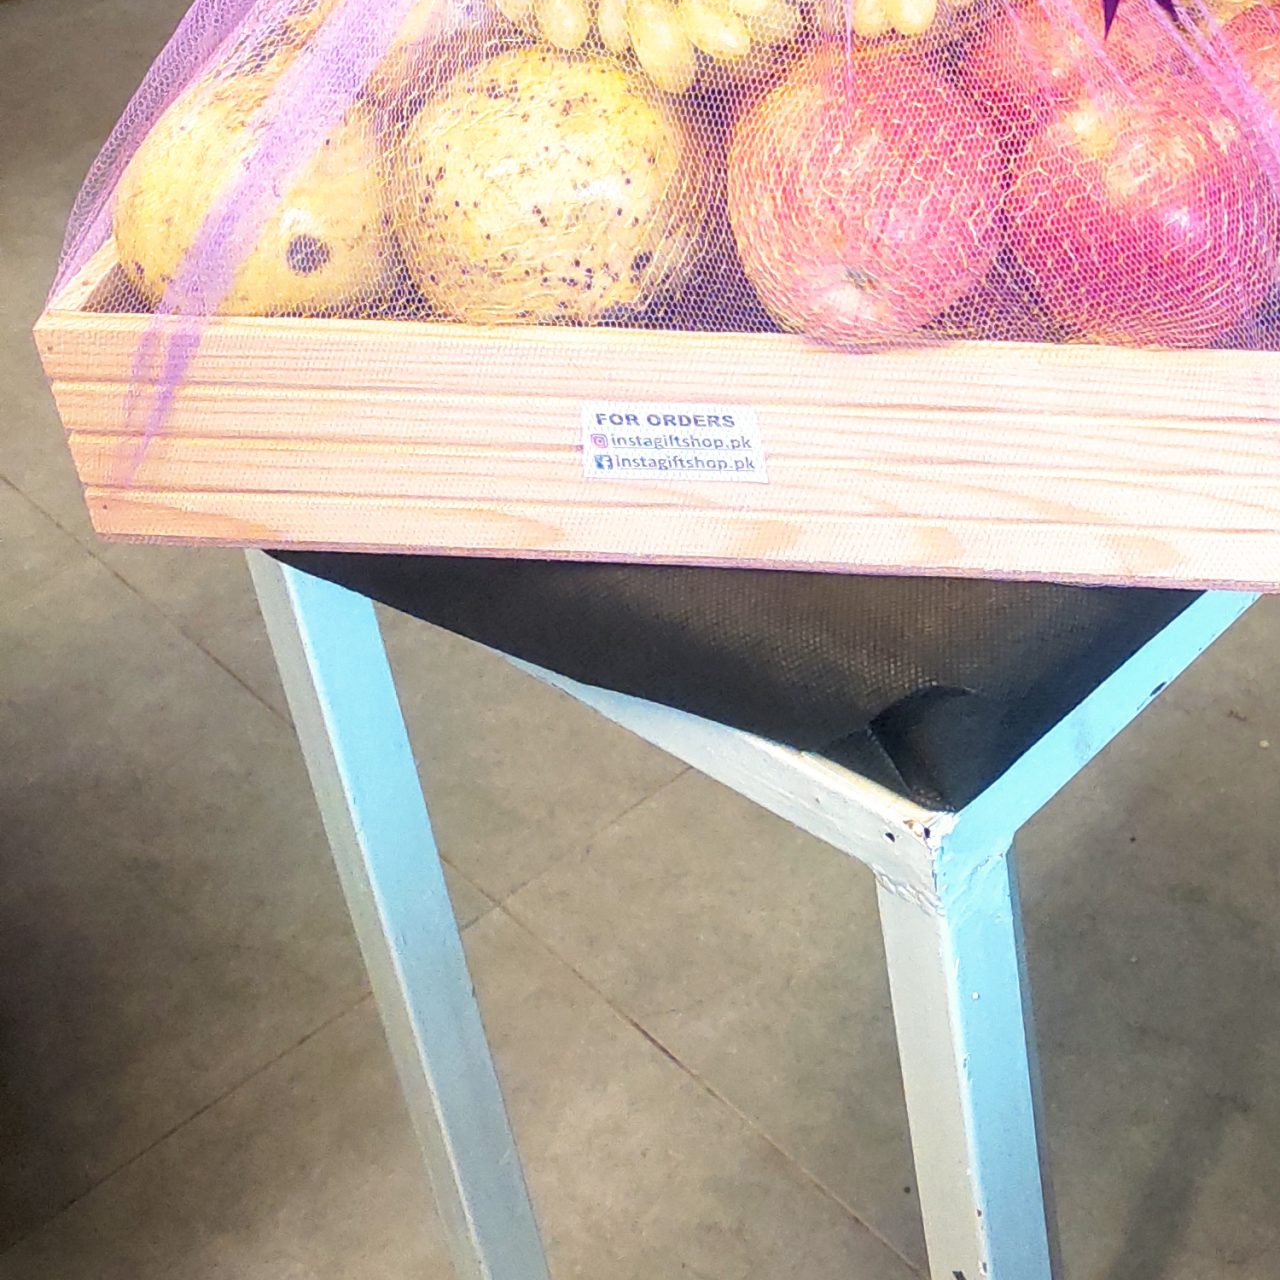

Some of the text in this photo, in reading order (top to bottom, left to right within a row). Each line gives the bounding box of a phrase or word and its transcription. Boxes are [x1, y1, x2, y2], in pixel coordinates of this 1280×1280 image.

[595, 413, 736, 428] FOR ORDERS
[611, 433, 753, 450] instagiftshop.pk
[615, 455, 756, 472] instagiftshop.pk
